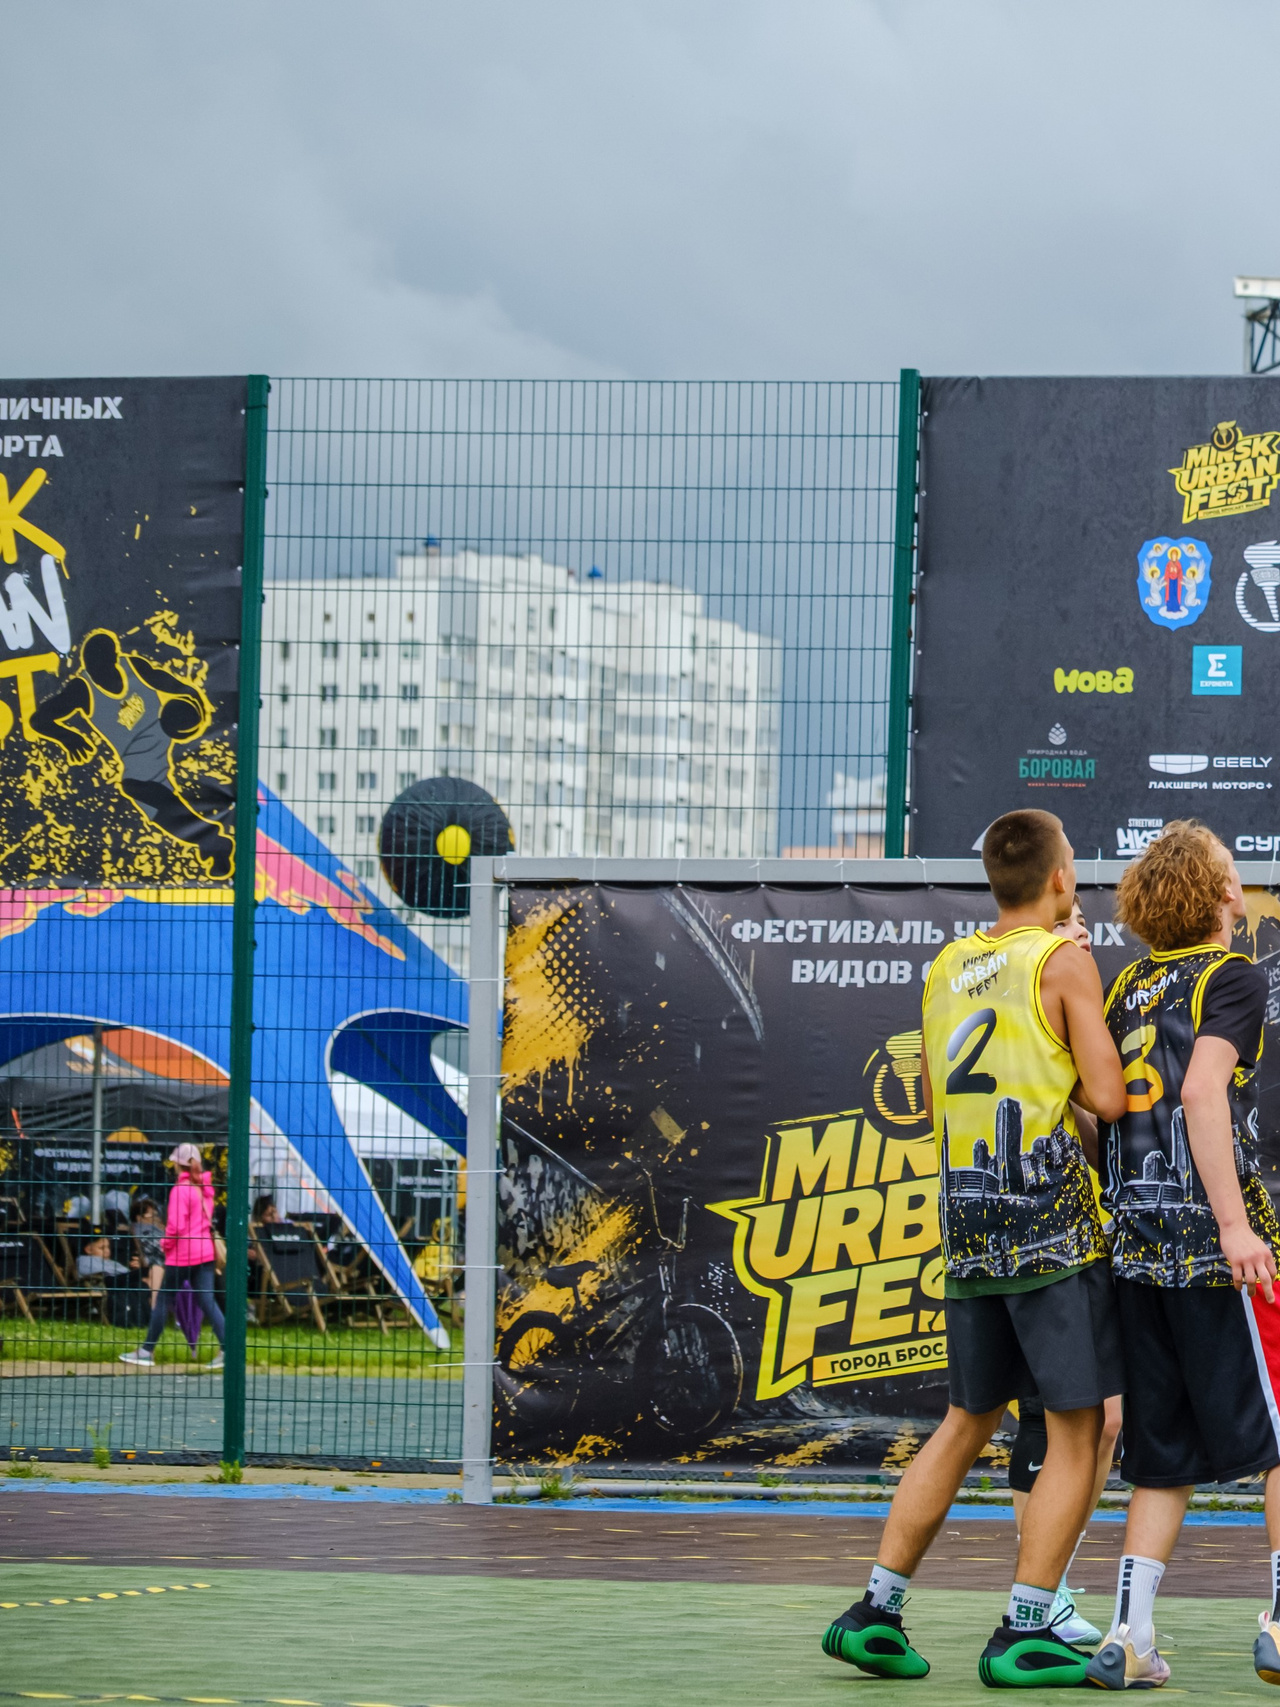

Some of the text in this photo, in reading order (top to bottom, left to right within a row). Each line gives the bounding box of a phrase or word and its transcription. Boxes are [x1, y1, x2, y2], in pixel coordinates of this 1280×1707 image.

[0, 434, 64, 457] РТА
[1186, 434, 1275, 470] MINSK
[1180, 453, 1279, 491] URBAN
[1189, 476, 1269, 517] FEST
[1018, 757, 1096, 779] БОРОВАЯ
[1212, 756, 1273, 768] GEELY
[1148, 781, 1208, 790] ЛАКШЕРИ
[731, 919, 945, 945] ФЕСТИВАЛЬ
[792, 959, 912, 988] ВИДОВ
[950, 952, 1008, 994] URBAN
[967, 972, 999, 1000] FEST
[1125, 969, 1178, 1011] URBAN
[945, 1007, 998, 1095] 2
[831, 1341, 947, 1375] ГОРОД БРОС
[1015, 1604, 1045, 1622] 96
